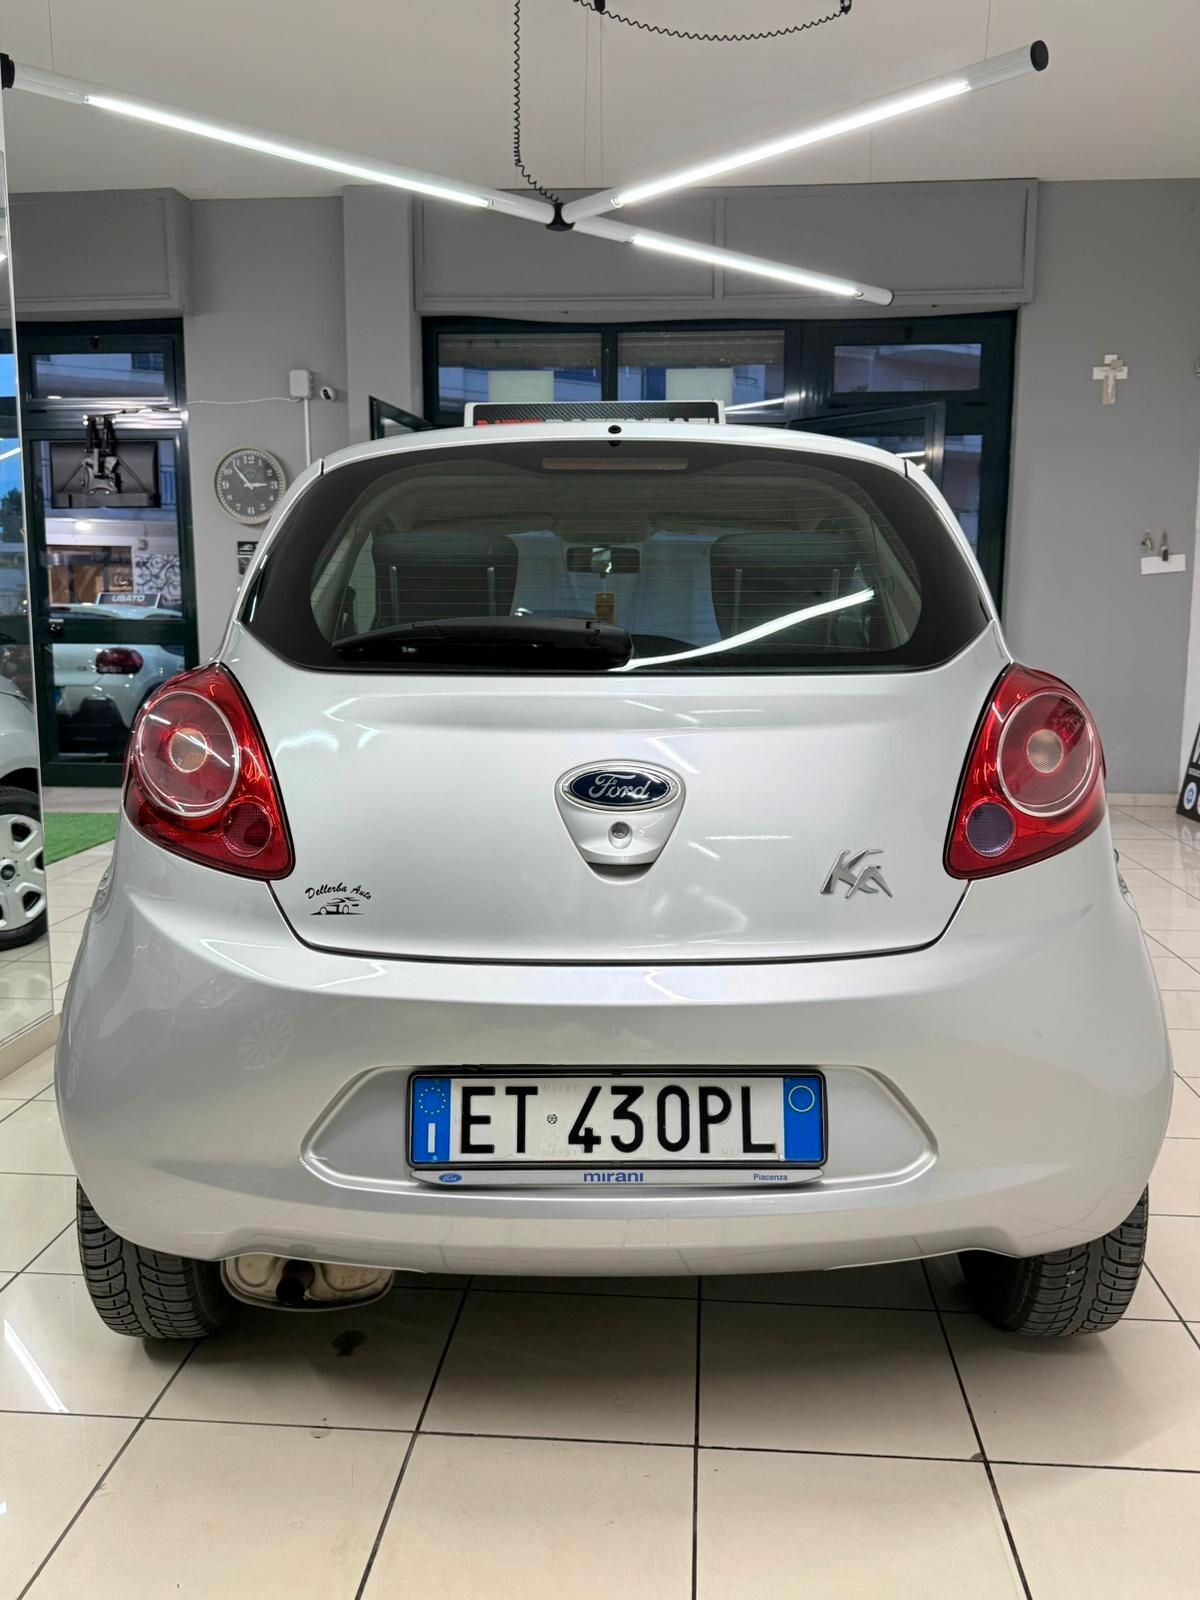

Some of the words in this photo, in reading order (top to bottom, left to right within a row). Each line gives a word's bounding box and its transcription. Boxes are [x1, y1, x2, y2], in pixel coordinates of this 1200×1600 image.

[242, 455, 256, 464] 12
[222, 480, 230, 489] 9
[270, 480, 278, 489] 3
[247, 506, 255, 515] 6
[112, 594, 146, 602] USATO
[588, 773, 652, 799] Ford
[305, 882, 348, 899] Dellerba
[350, 885, 372, 899] Auto
[460, 1085, 539, 1154] ET
[568, 1084, 776, 1154] 430PL
[427, 1122, 437, 1154] I
[583, 1171, 644, 1182] mirani
[753, 1173, 788, 1181] Piacenza
